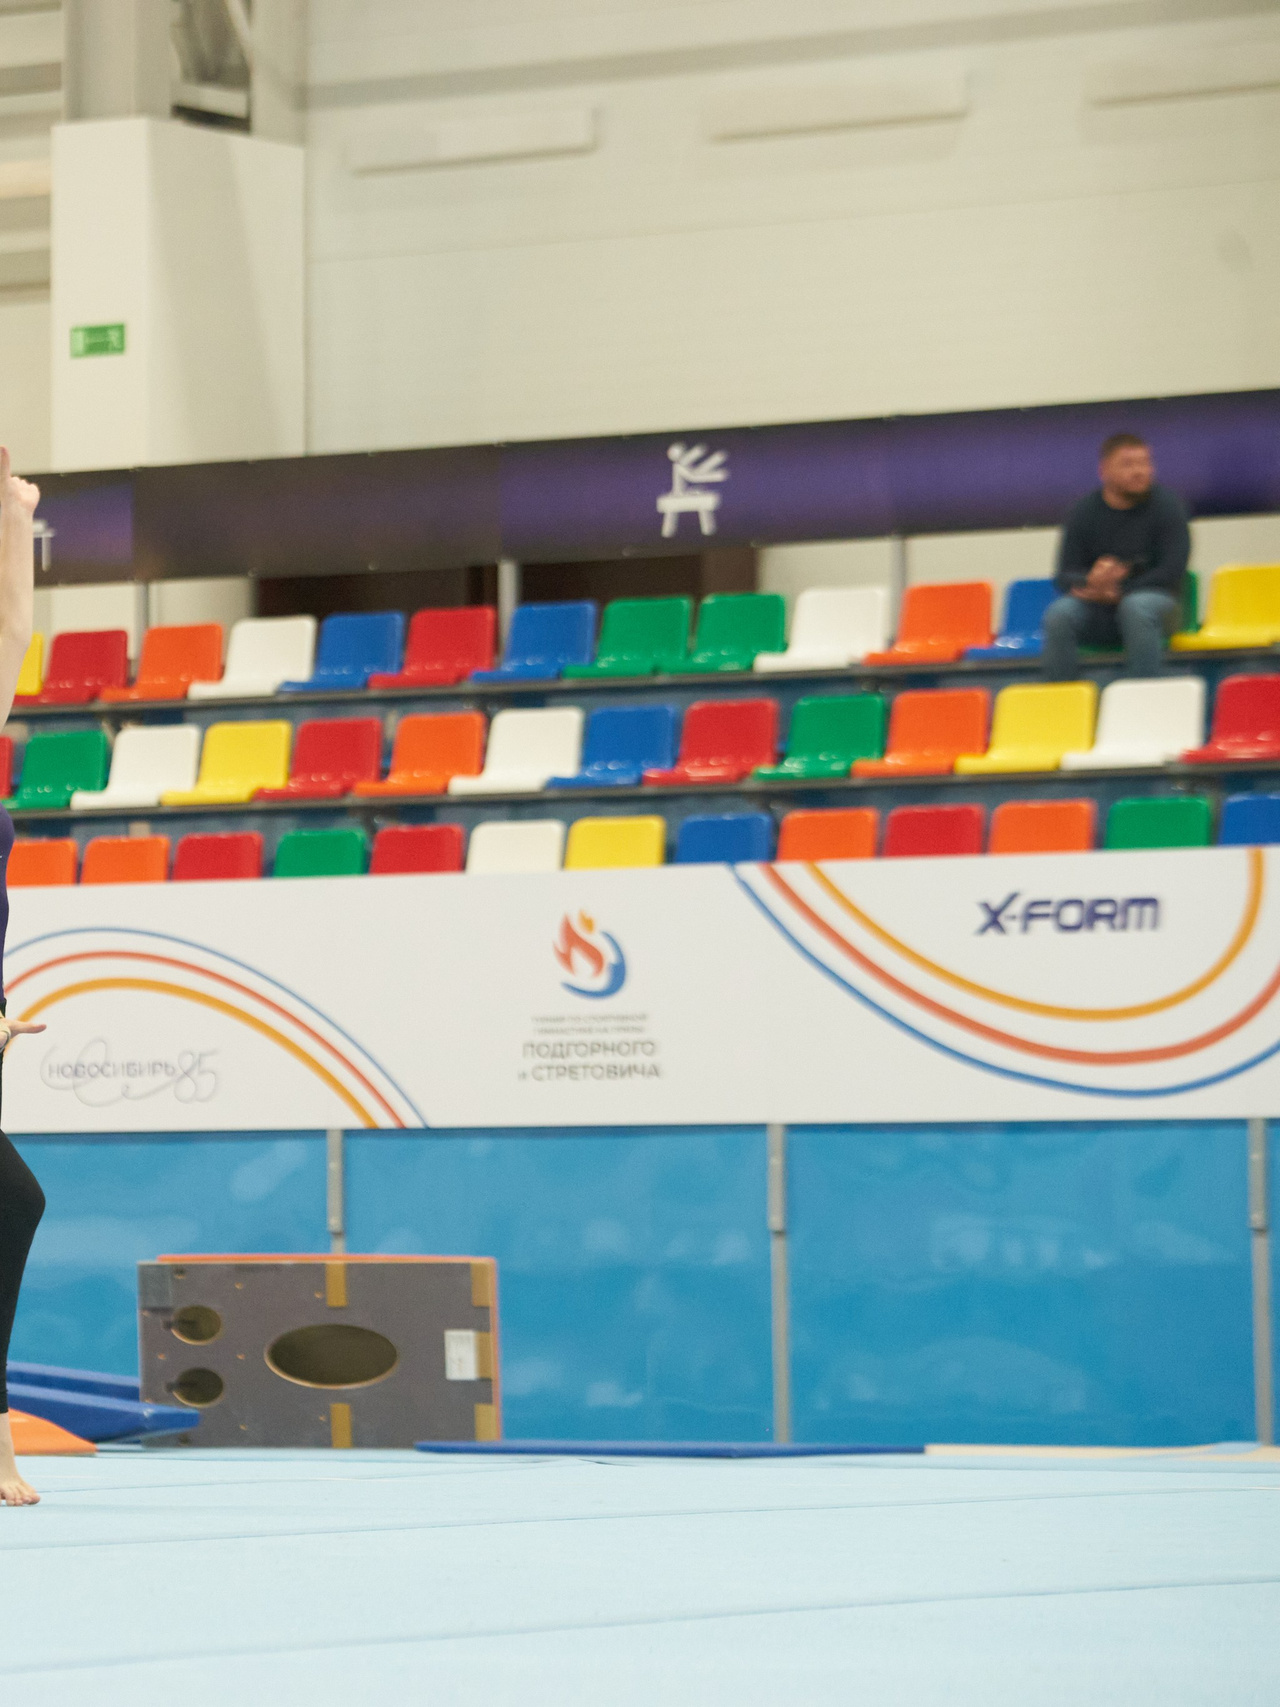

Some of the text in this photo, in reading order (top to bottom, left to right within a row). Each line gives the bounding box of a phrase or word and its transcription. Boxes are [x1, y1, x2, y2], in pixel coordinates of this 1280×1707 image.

[974, 891, 1160, 936] X-FORM
[522, 1041, 656, 1060] ПОДГОРНОГО
[531, 1063, 661, 1081] СТРЕТОВИЧА
